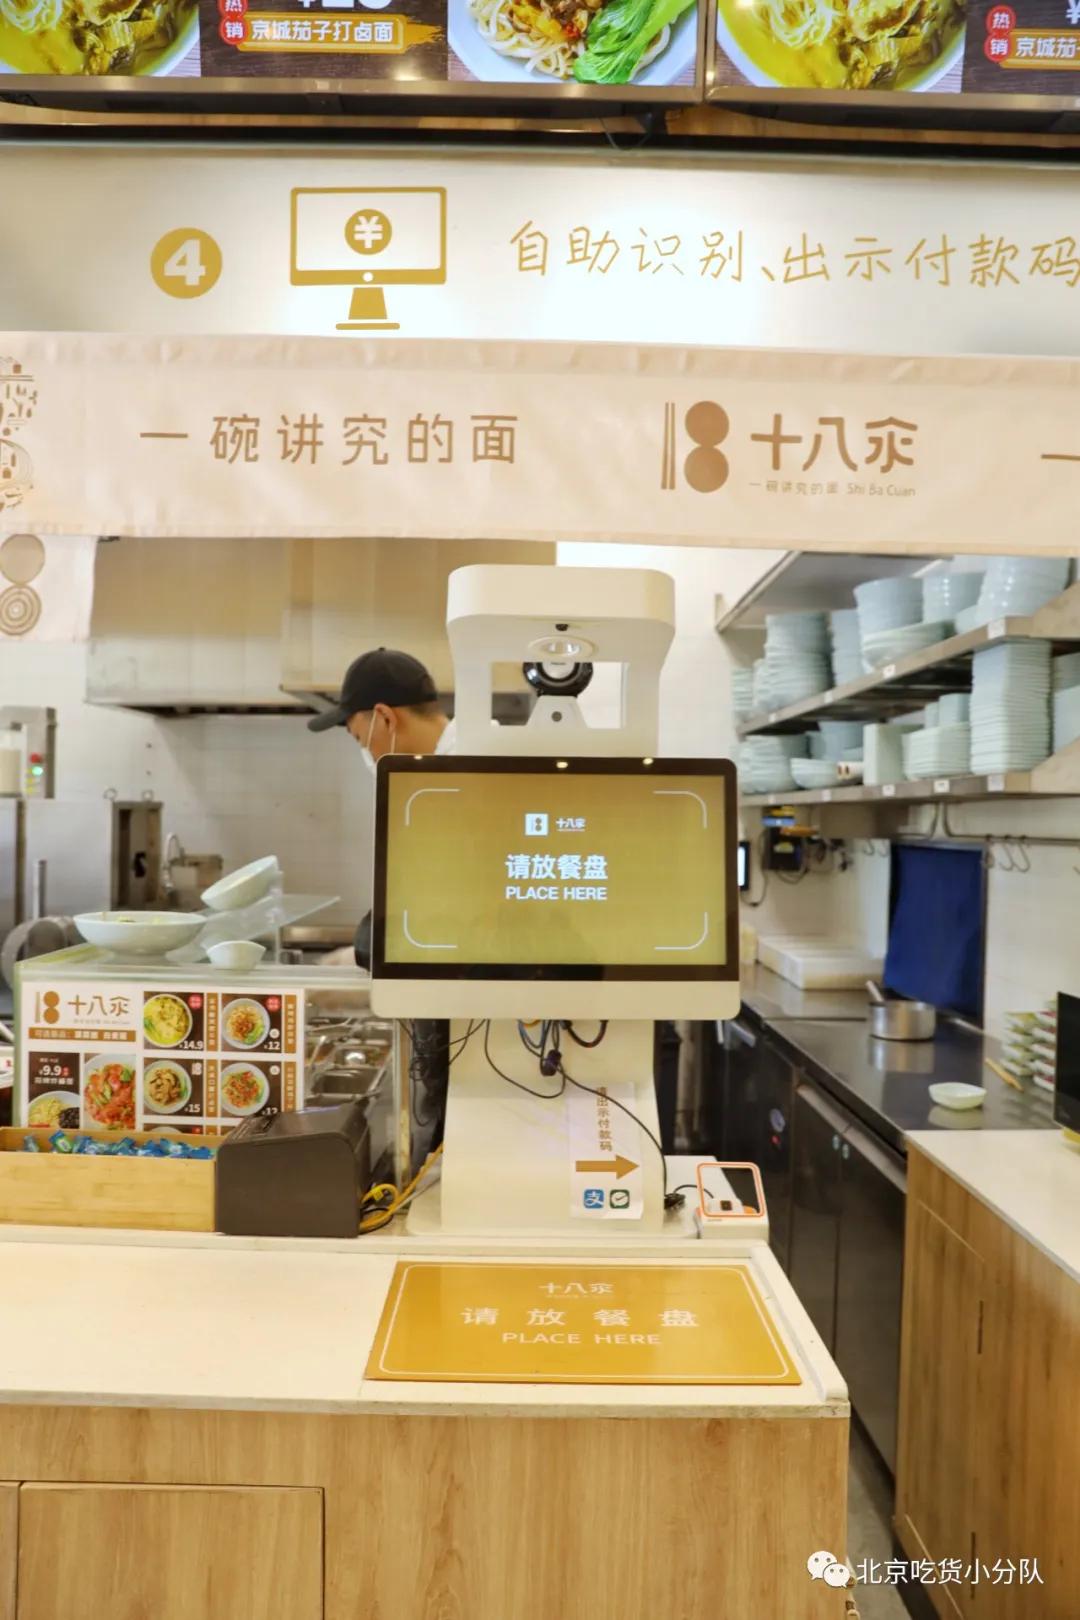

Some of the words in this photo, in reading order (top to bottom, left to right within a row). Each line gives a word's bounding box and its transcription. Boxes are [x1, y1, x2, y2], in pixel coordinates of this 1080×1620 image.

[250, 20, 394, 43] 京城茄子打卤面
[1015, 37, 1080, 58] 京城茄
[163, 239, 206, 286] 4
[139, 412, 519, 465] 一碗讲究的面
[505, 854, 608, 879] 请放餐盘
[506, 886, 559, 900] PLACE
[563, 886, 608, 900] HERE
[460, 1307, 700, 1327] 请放餐盘
[501, 1333, 582, 1345] PLACE
[594, 1333, 662, 1346] HERE
